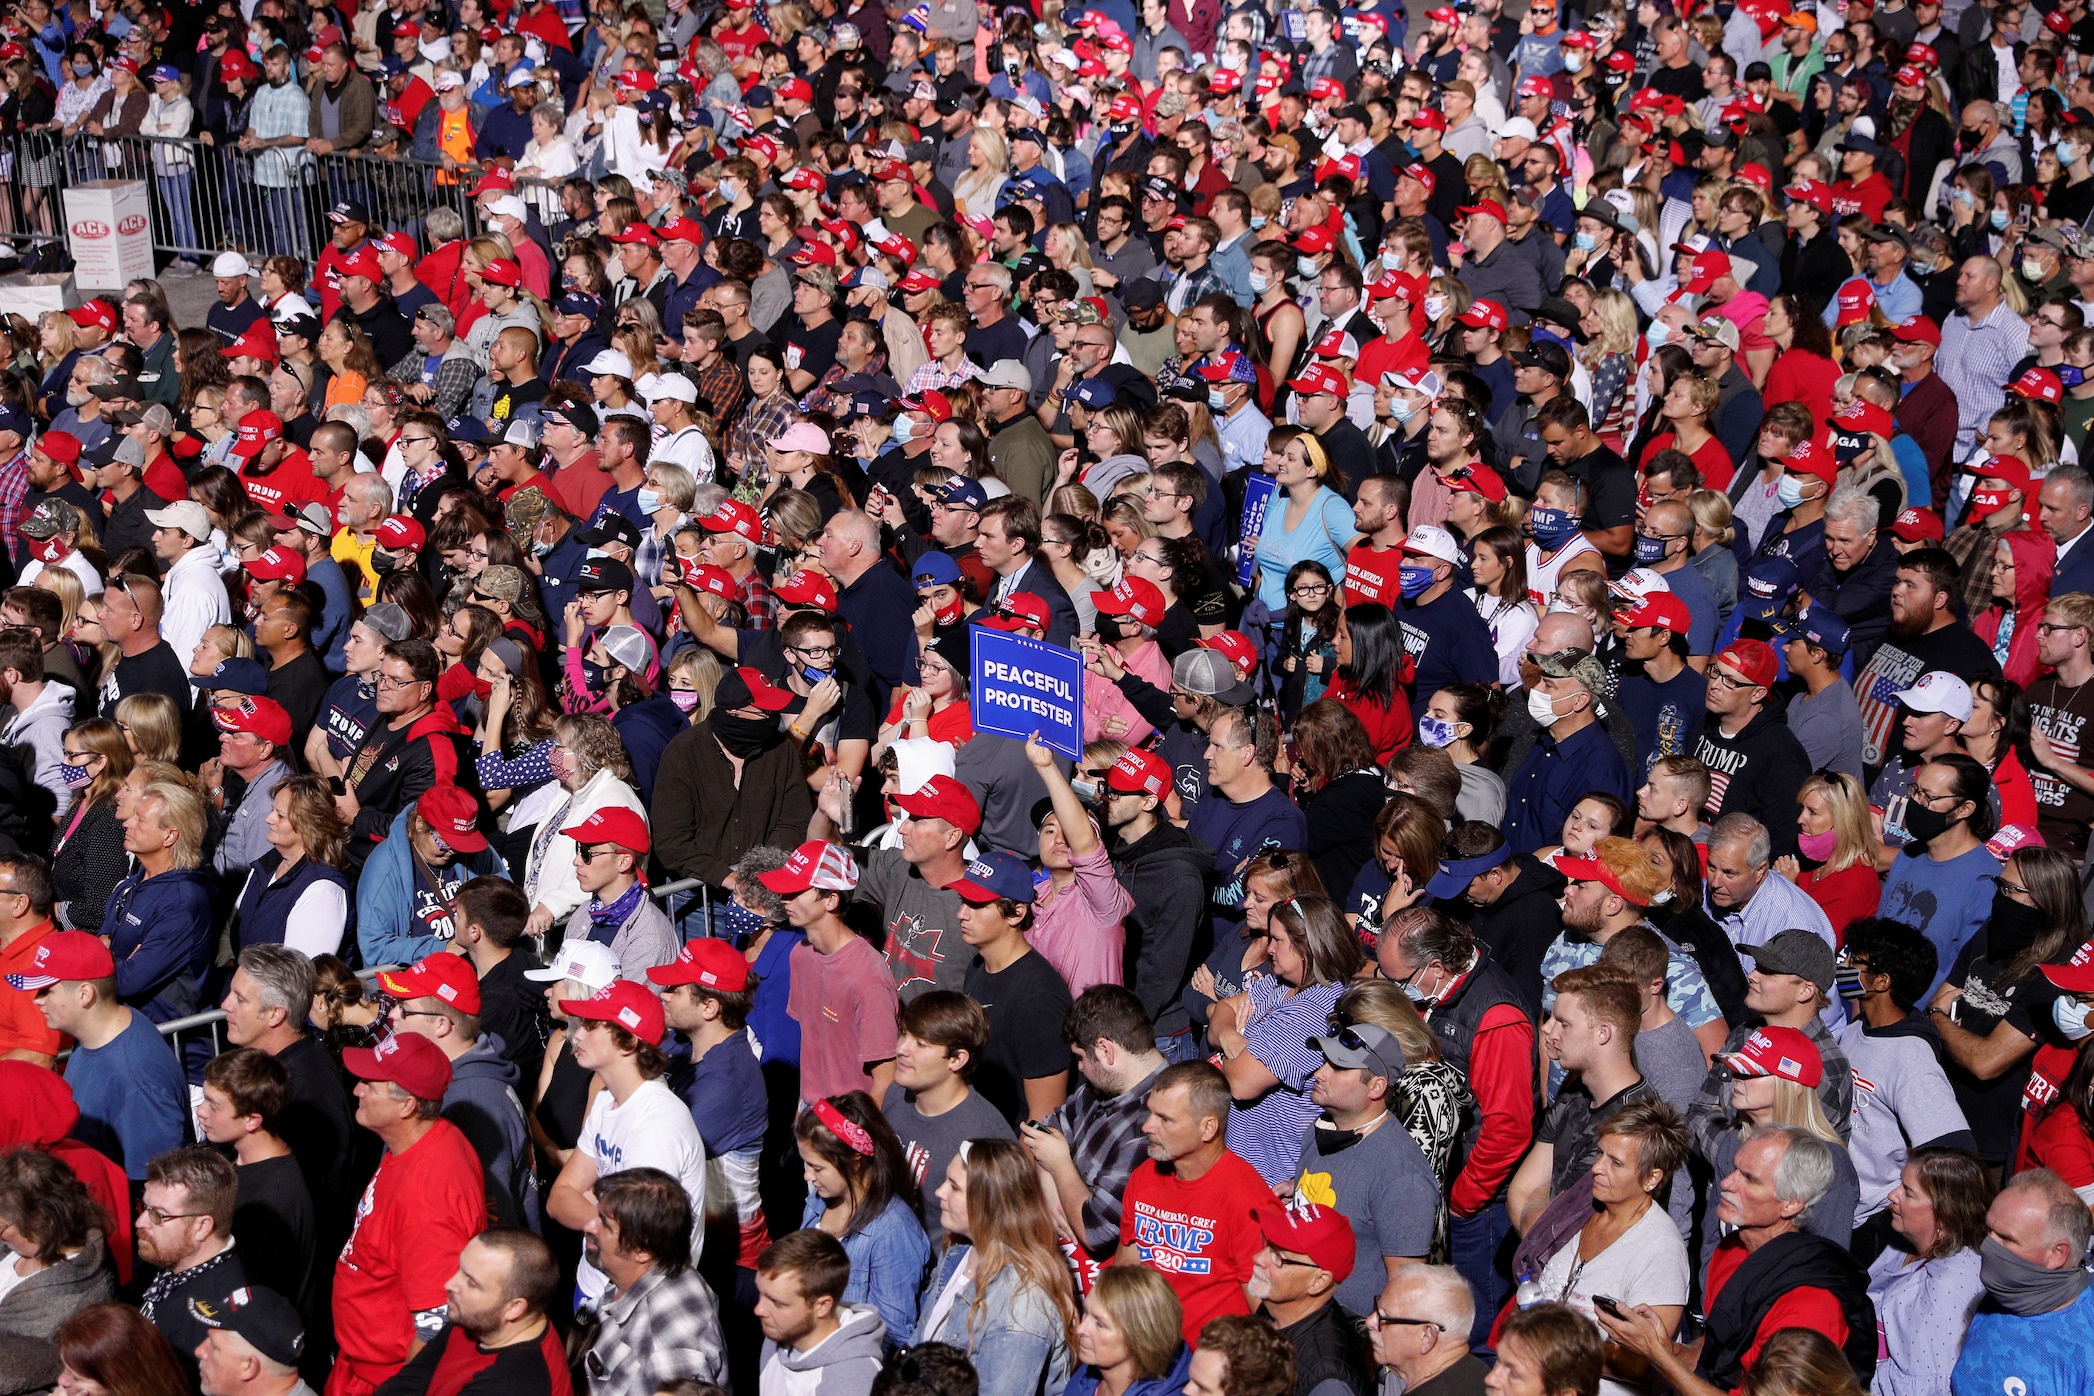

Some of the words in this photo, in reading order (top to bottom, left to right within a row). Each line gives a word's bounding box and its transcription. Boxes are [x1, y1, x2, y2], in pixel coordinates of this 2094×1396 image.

[1256, 78, 1273, 87] GA
[1605, 74, 1622, 84] GA
[75, 221, 107, 233] ACE
[120, 216, 146, 232] ACE
[248, 483, 283, 500] TRUMP
[1359, 568, 1384, 587] AMERICA
[1748, 576, 1777, 594] TRUMP
[1877, 642, 1907, 668] BIKERS
[1906, 654, 1927, 672] FOR
[1864, 651, 1916, 687] TRUMP
[984, 660, 1074, 703] PEACEFUL
[985, 688, 1073, 728] PROTESTER
[1028, 733, 1043, 742] 20
[1693, 734, 1747, 776] TRUMP
[2034, 779, 2057, 792] BILL
[1357, 929, 1376, 946] 202
[2028, 1076, 2059, 1105] TRU
[1132, 1201, 1153, 1218] KEEP
[1133, 1214, 1218, 1255] TRUMP
[193, 1305, 222, 1329] PRESIDENT
